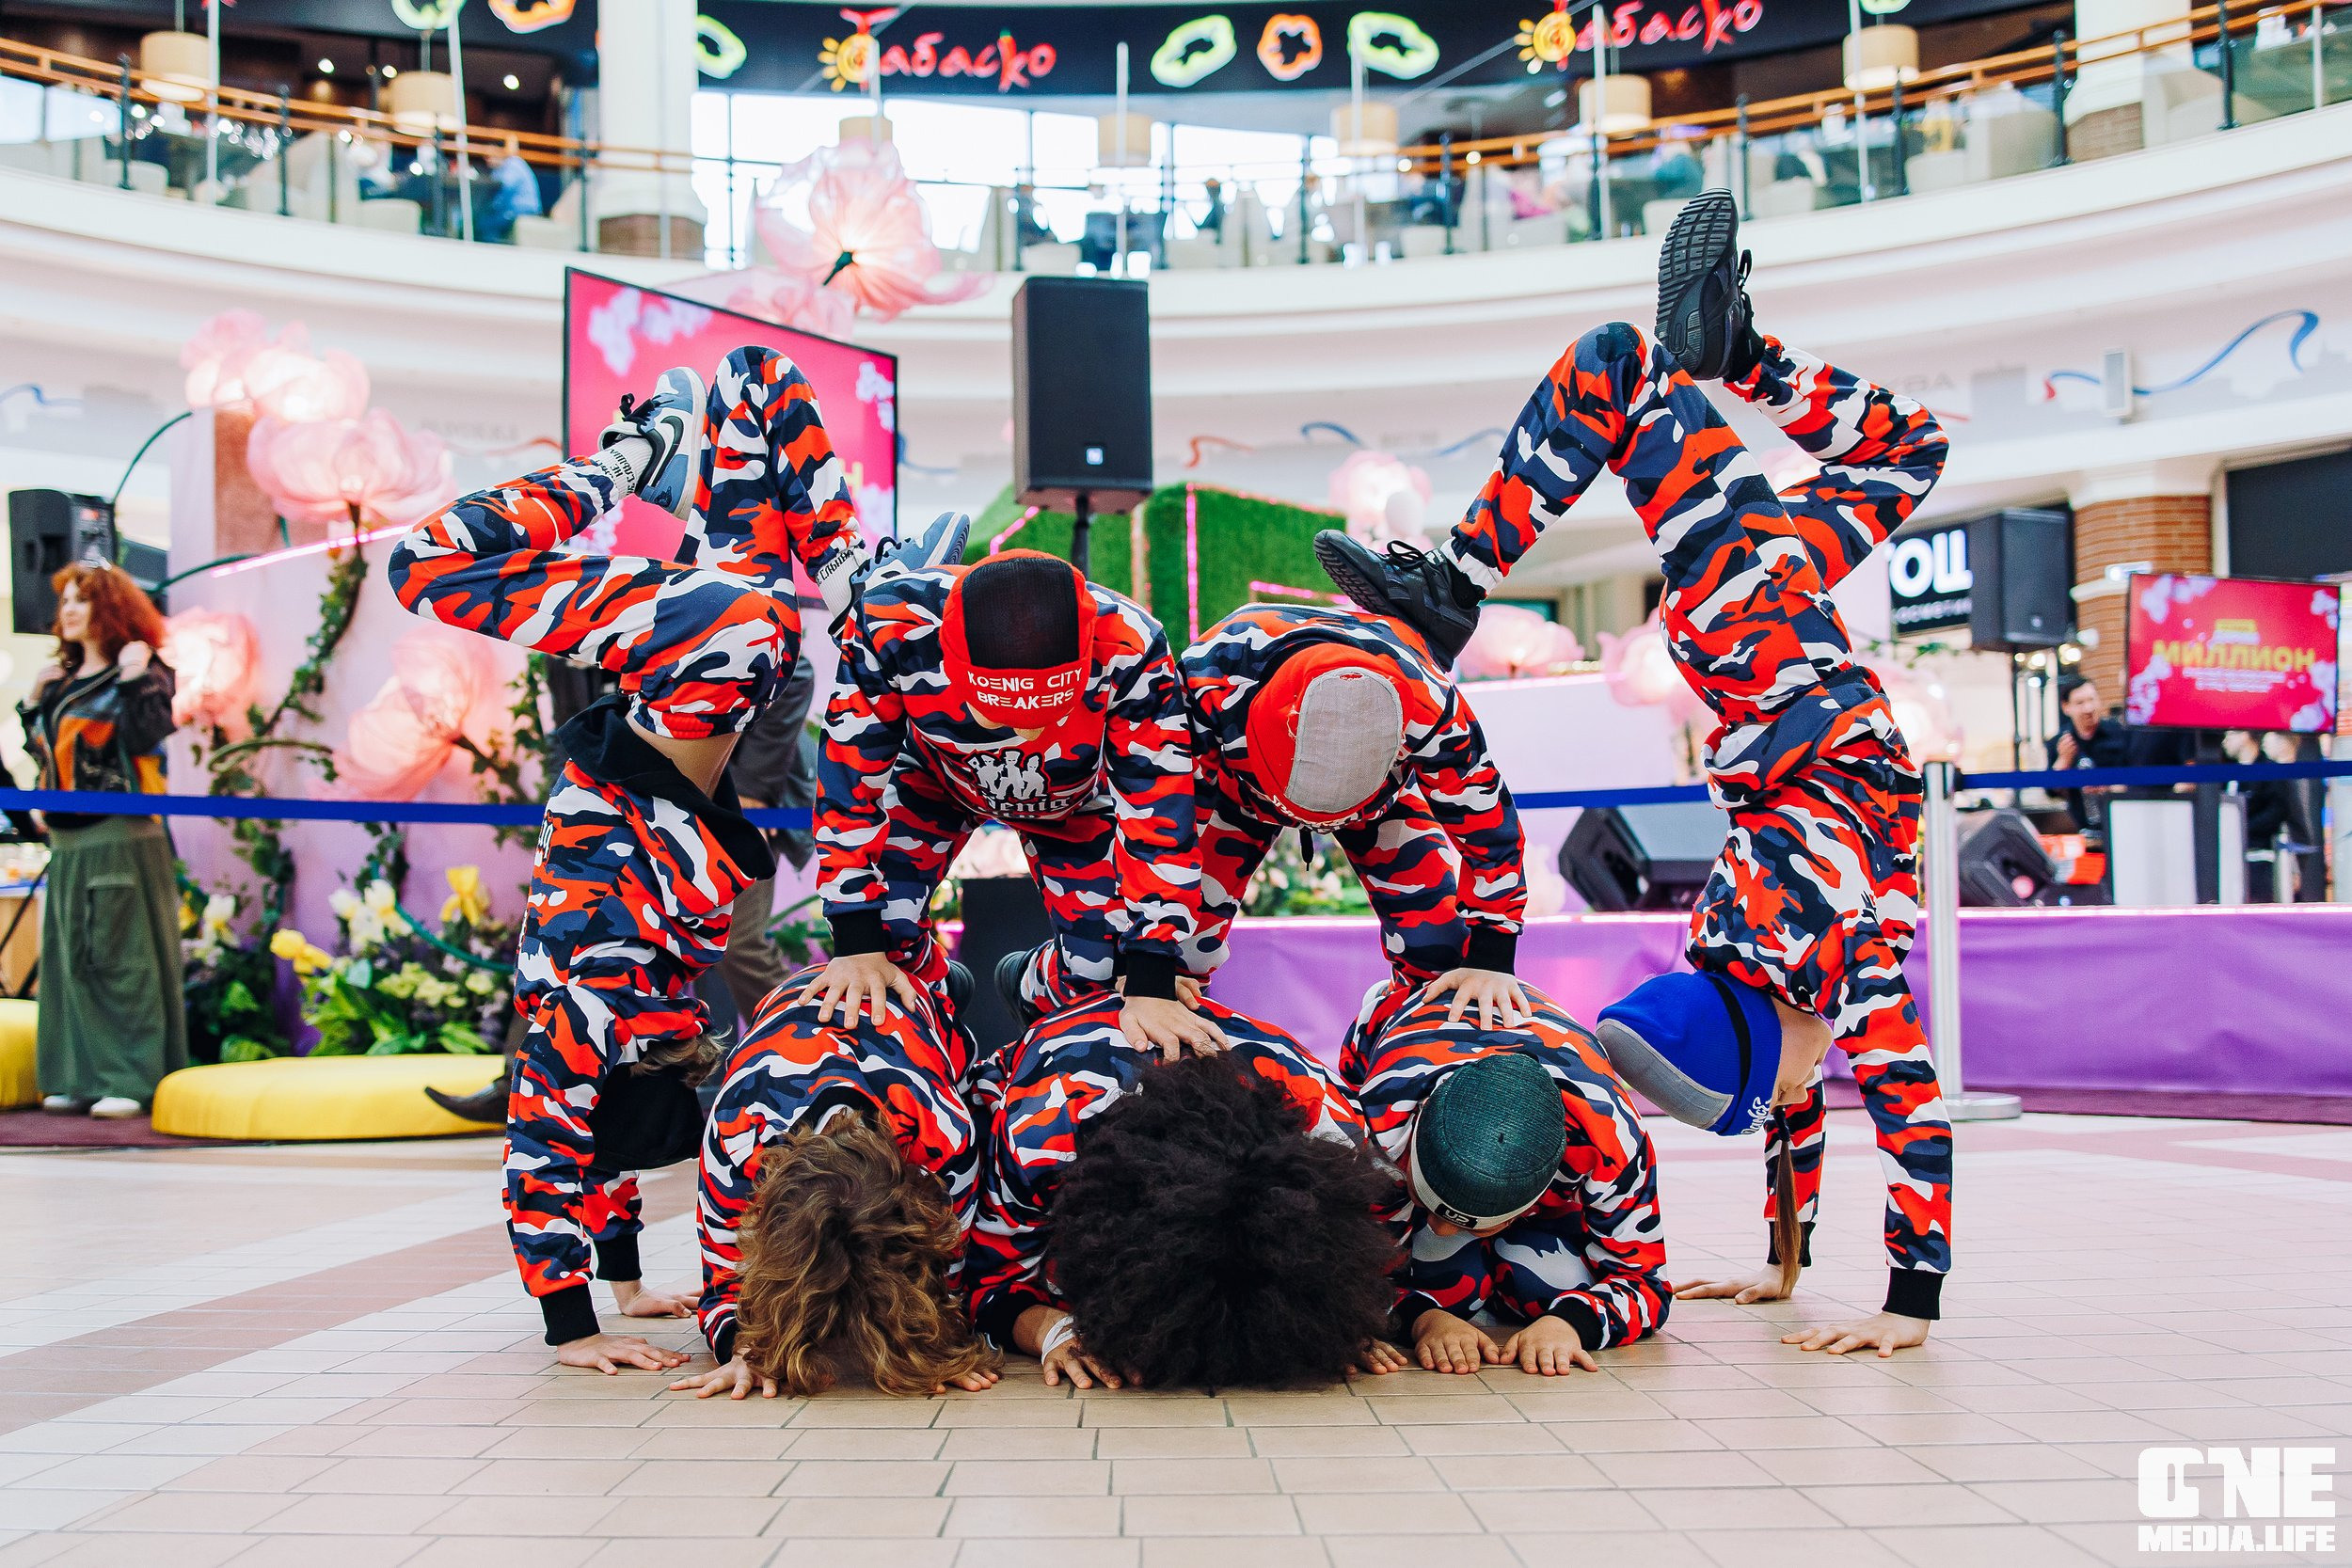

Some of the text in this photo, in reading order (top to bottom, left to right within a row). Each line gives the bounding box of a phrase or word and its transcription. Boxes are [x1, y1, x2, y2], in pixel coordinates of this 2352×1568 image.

[967, 667, 1082, 692] KOENIG CITY
[977, 688, 1074, 710] BREAKERS
